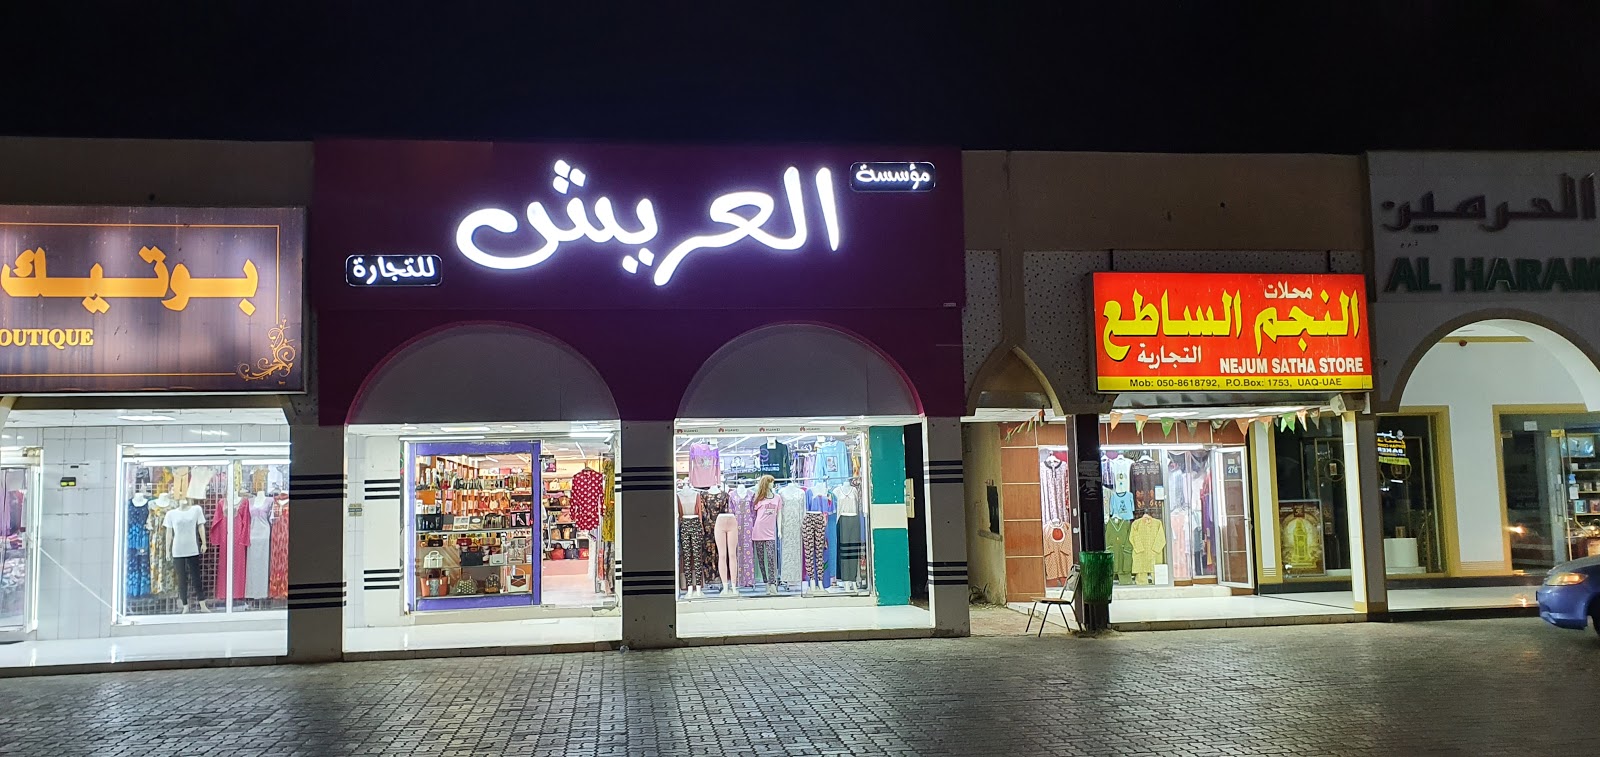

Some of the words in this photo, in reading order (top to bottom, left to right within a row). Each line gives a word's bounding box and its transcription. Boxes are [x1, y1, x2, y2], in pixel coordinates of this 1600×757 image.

[855, 163, 932, 188] مؤسسة
[1381, 172, 1596, 232] الحرمين
[456, 159, 839, 286] العريش
[0, 246, 259, 315] بوتيك
[352, 255, 437, 285] للتجارة
[1384, 257, 1442, 292] AL
[1264, 280, 1313, 300] محلات
[1103, 288, 1243, 361] الساطع
[1254, 289, 1361, 356] النجم
[0, 328, 95, 350] OUTIQUE
[1137, 343, 1202, 370] التجارية
[1219, 357, 1268, 374] NEJUM
[1271, 357, 1316, 373] SATHA
[1319, 357, 1364, 373] STORE
[1129, 379, 1154, 387] Mob:
[1156, 379, 1220, 389] 050-8618792,
[1225, 379, 1265, 388] P.O.Box:
[1268, 379, 1292, 388] 1753,
[1297, 378, 1343, 387] UAQ-UAE
